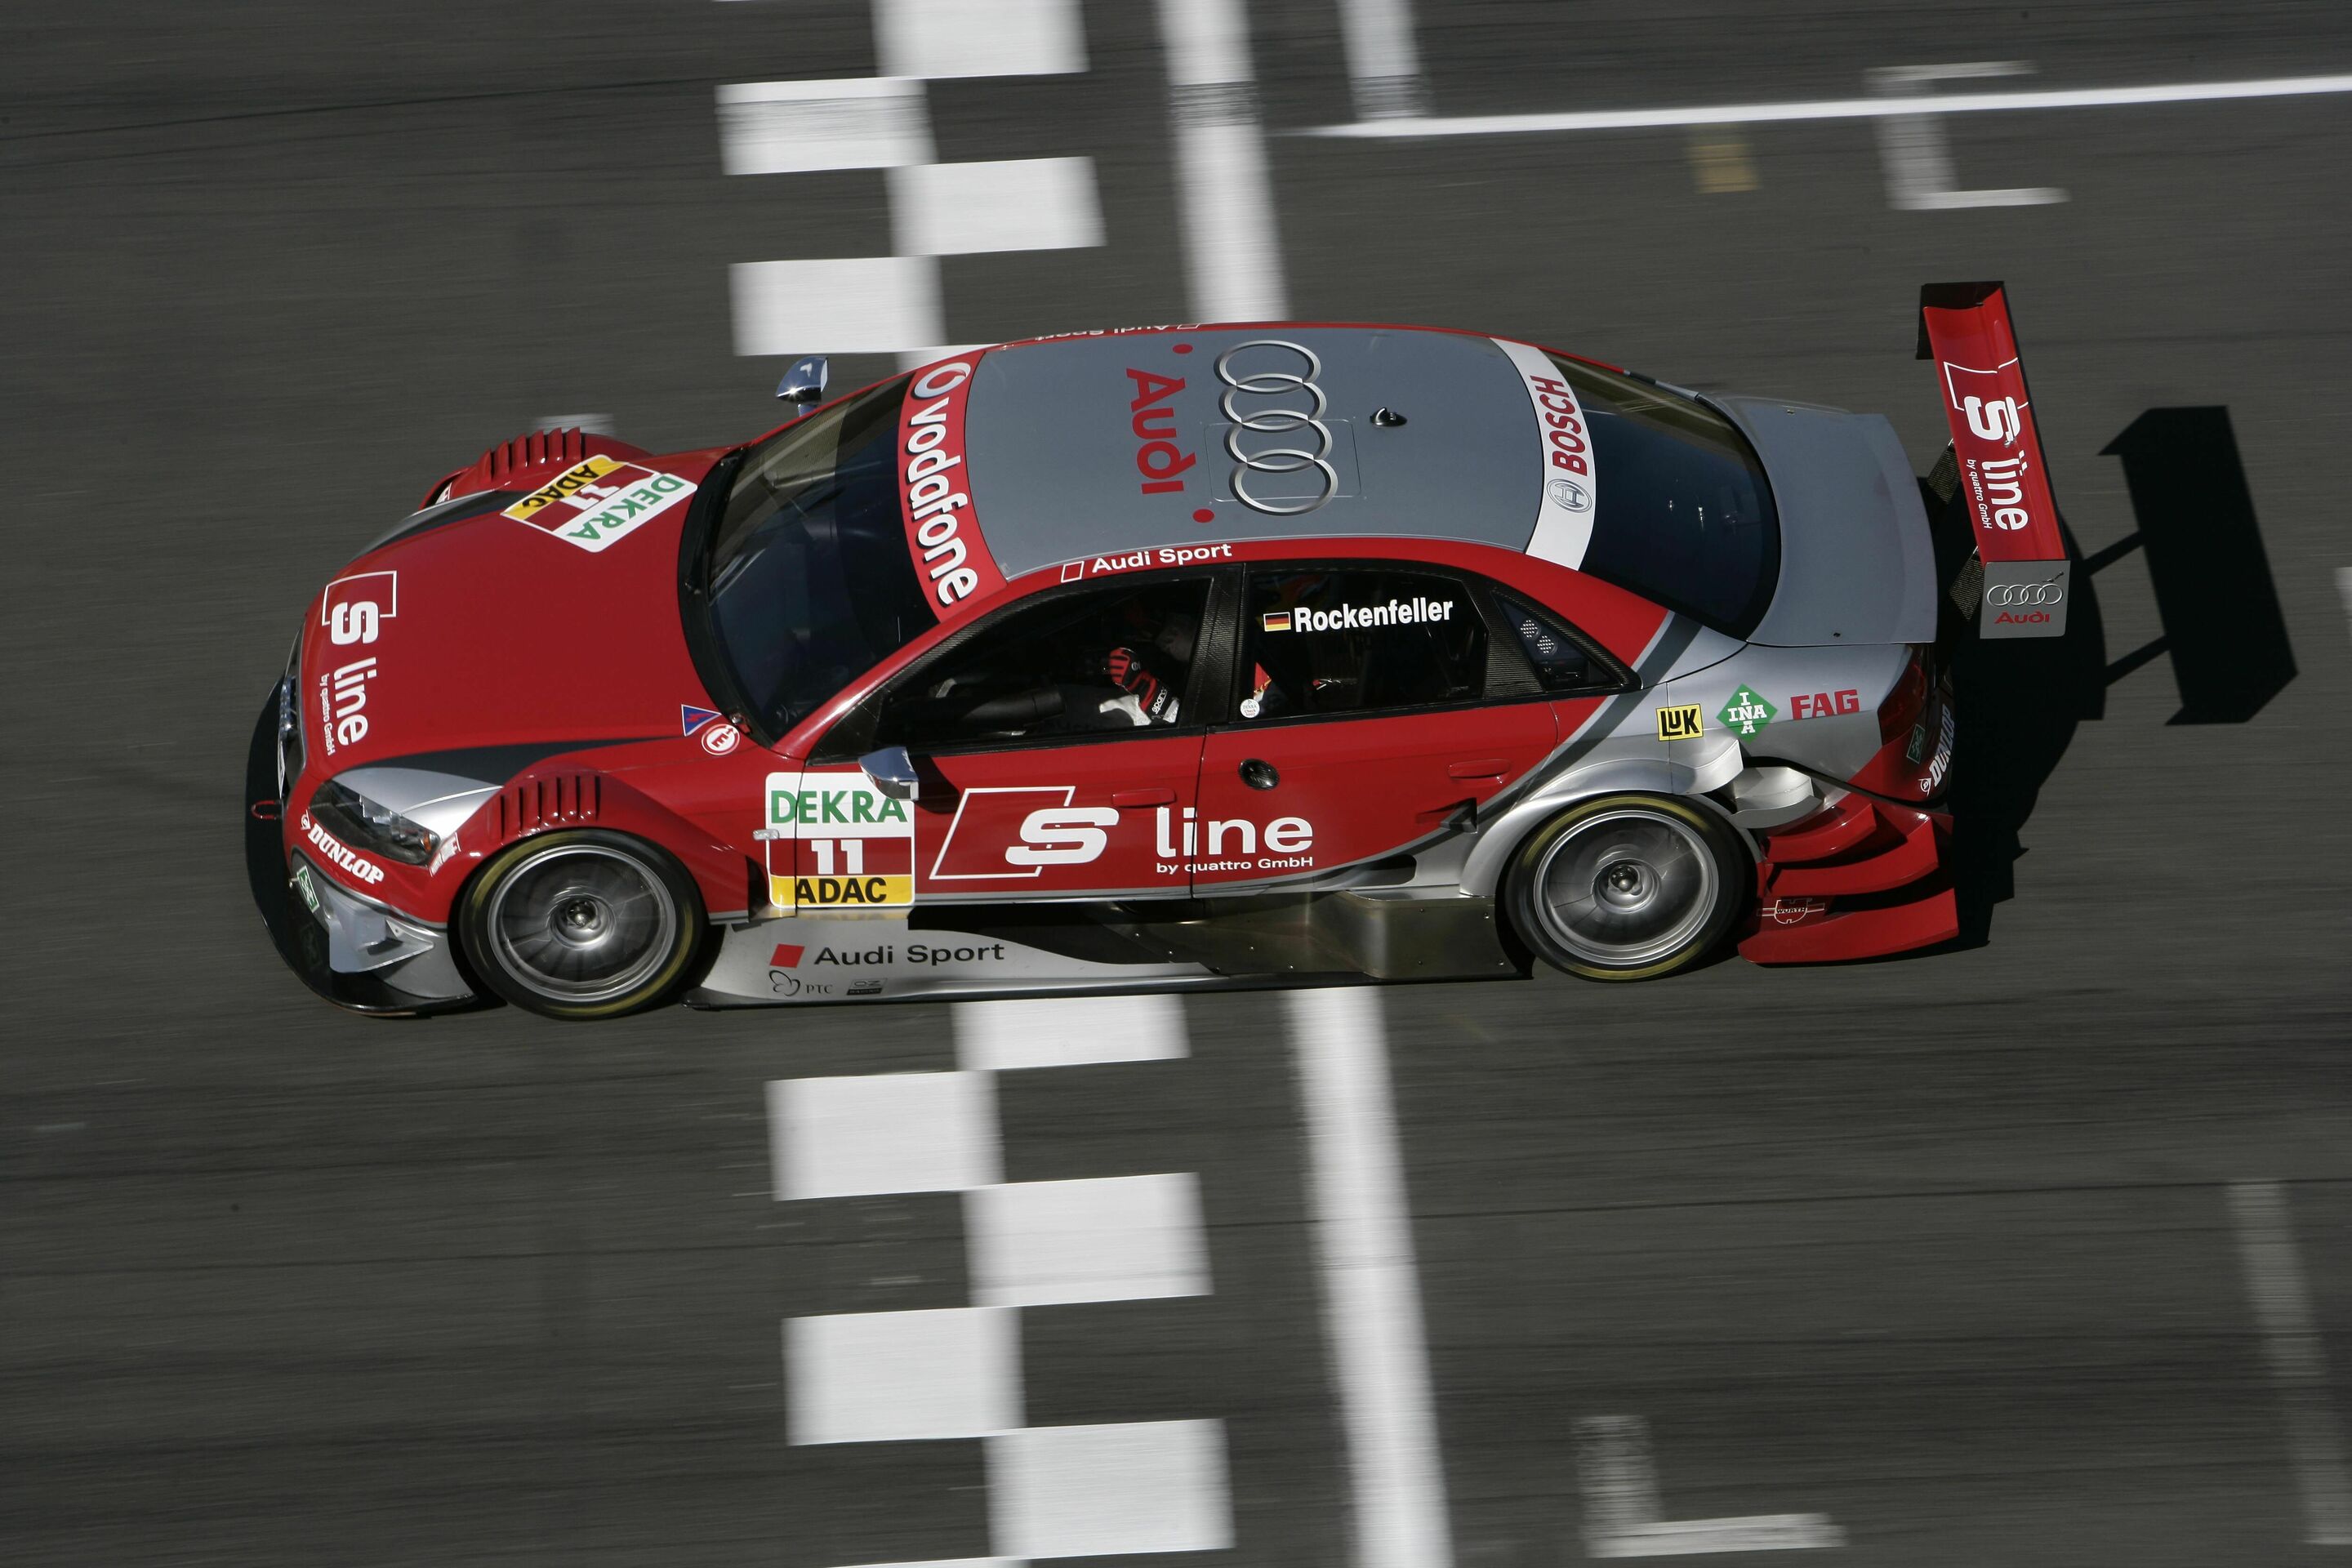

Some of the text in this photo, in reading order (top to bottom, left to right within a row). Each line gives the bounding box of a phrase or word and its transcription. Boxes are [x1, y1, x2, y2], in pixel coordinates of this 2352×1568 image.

[1126, 368, 1196, 495] Audi
[1530, 375, 1588, 476] BOSCH
[522, 464, 599, 509] ADAC
[559, 483, 621, 511] 11
[906, 396, 978, 606] vodafone
[1967, 459, 1993, 530] by quattro GmbH
[1982, 451, 2029, 532] line
[566, 474, 685, 540] DEKRA
[1091, 542, 1232, 574] Audi Sport
[1294, 597, 1454, 632] Rockenfeller
[1994, 611, 2050, 624] Audi
[331, 600, 379, 746] S line
[1727, 704, 1767, 722] INA
[1790, 688, 1860, 719] FAG
[1928, 703, 1955, 788] DUNLOP
[771, 789, 908, 825] DEKRA
[307, 822, 385, 885] DUNLOP
[1005, 806, 1314, 866] S line
[811, 839, 863, 875] 11
[1156, 856, 1314, 875] by quattro GmbH
[794, 877, 888, 904] ADAC
[813, 943, 1005, 966] Audi Sport
[806, 984, 834, 995] PTC
